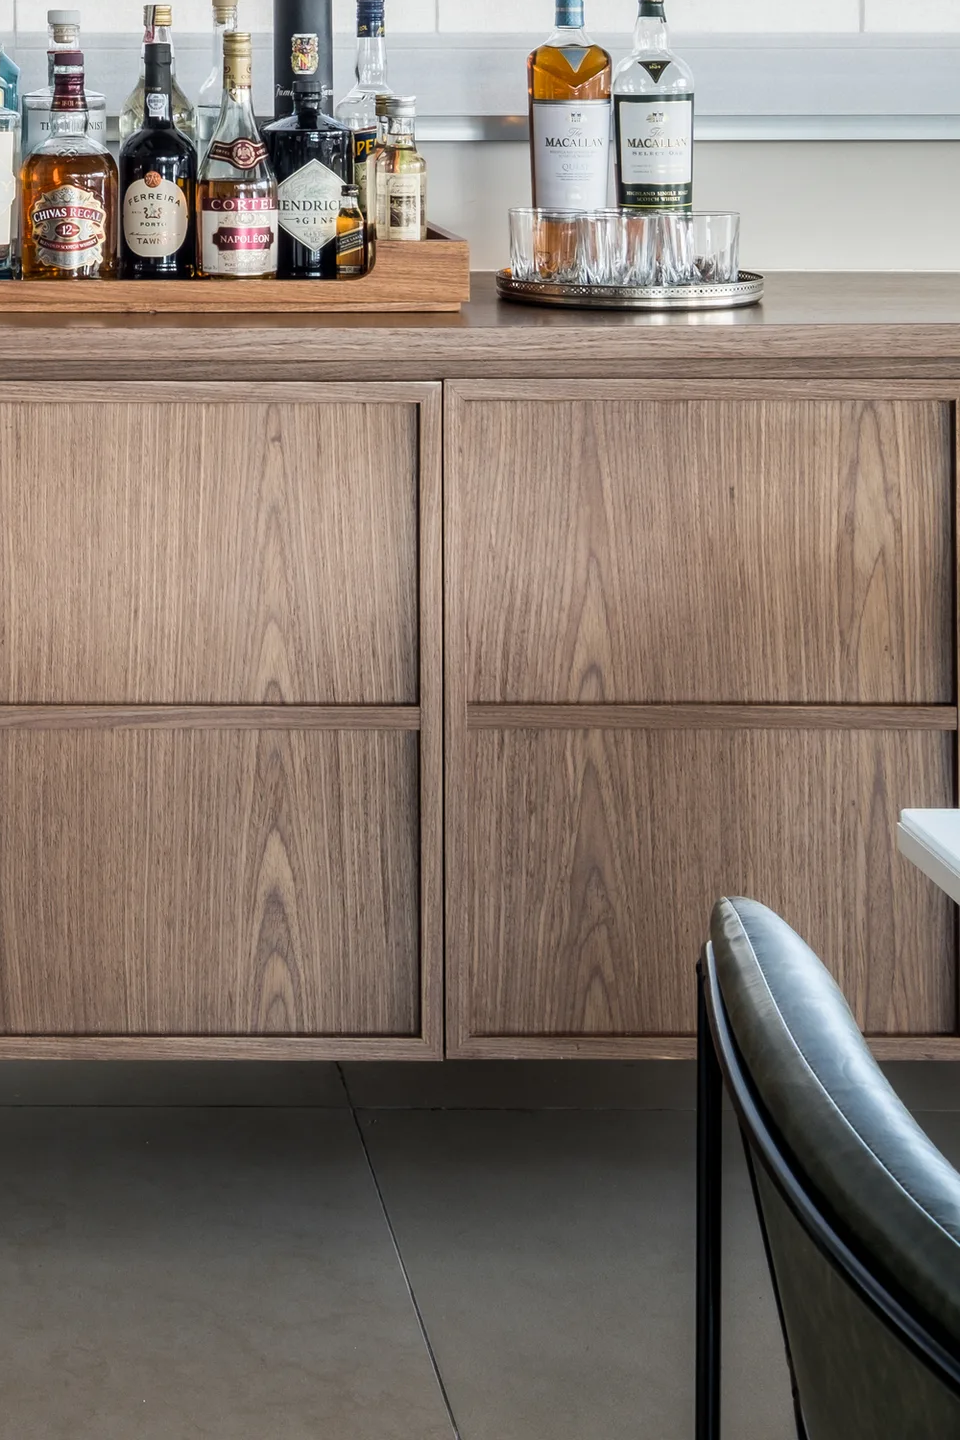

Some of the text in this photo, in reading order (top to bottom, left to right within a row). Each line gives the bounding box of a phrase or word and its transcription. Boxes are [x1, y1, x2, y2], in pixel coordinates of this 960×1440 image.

[545, 137, 604, 148] MACALLAN
[627, 137, 688, 148] MACALLAN
[128, 192, 181, 207] FERREIRA
[210, 199, 276, 211] CORTEL
[33, 207, 102, 222] CHIVAS REGAL
[302, 216, 328, 225] GIN
[62, 224, 73, 235] 12
[220, 233, 270, 244] NAPOLÉON
